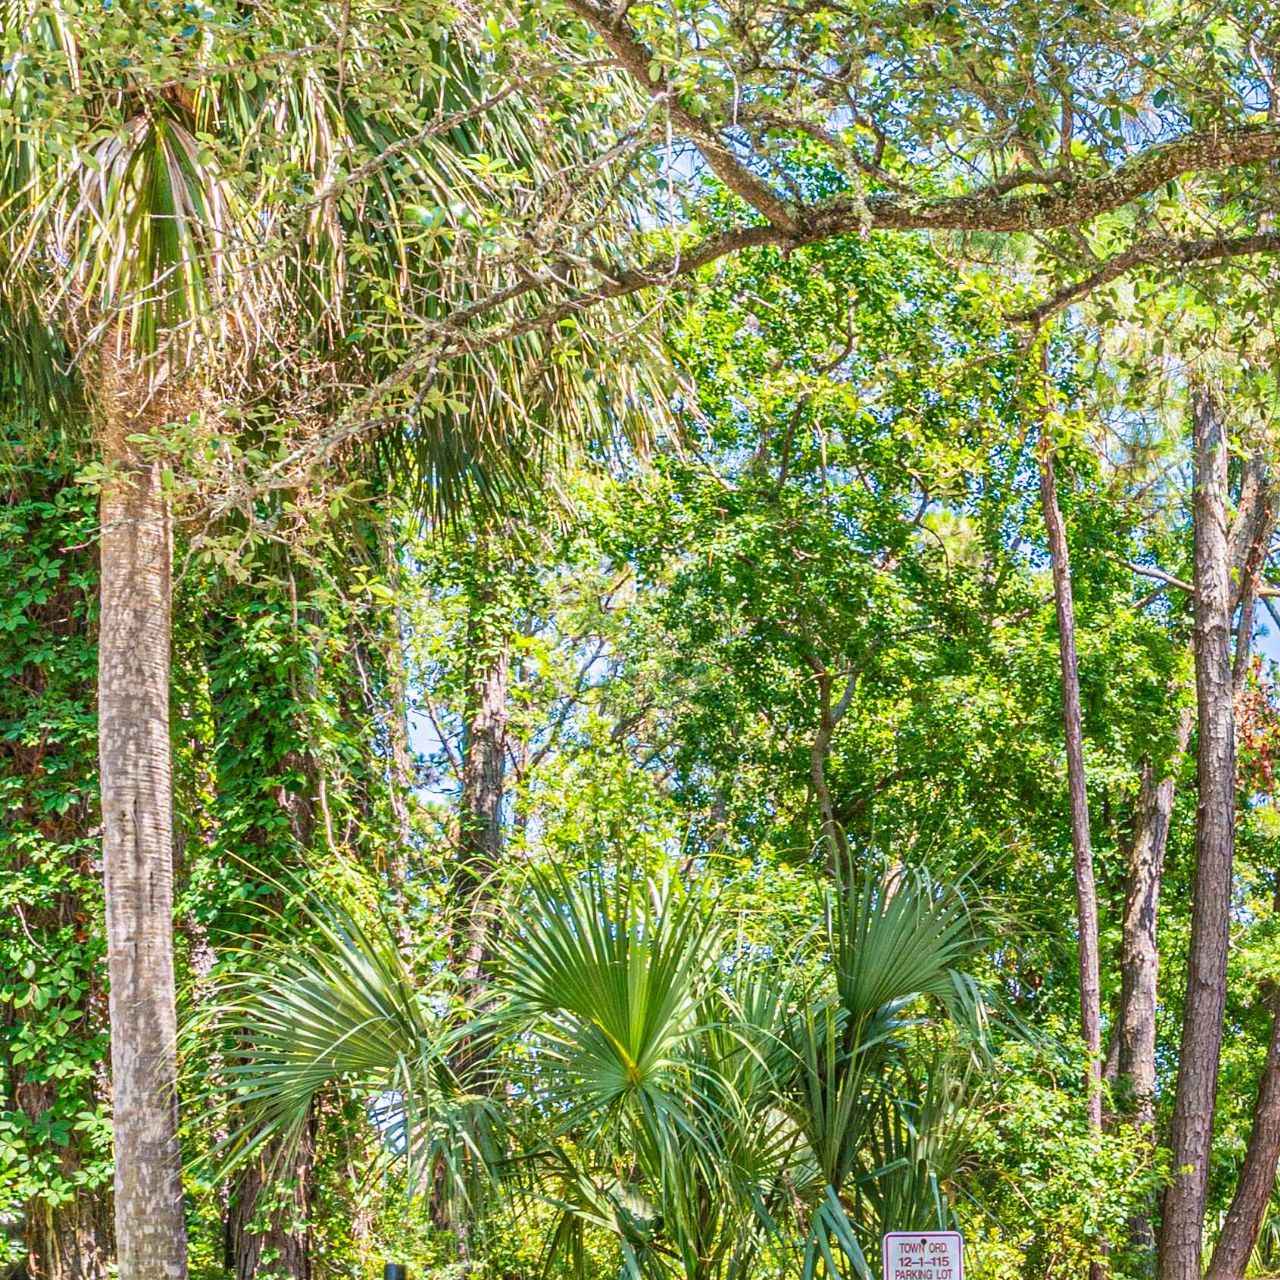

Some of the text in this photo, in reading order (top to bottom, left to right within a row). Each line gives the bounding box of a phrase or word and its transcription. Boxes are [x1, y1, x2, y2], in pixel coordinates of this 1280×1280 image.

[899, 1243, 925, 1253] TOWN
[895, 1269, 952, 1280] PARKING LOT
